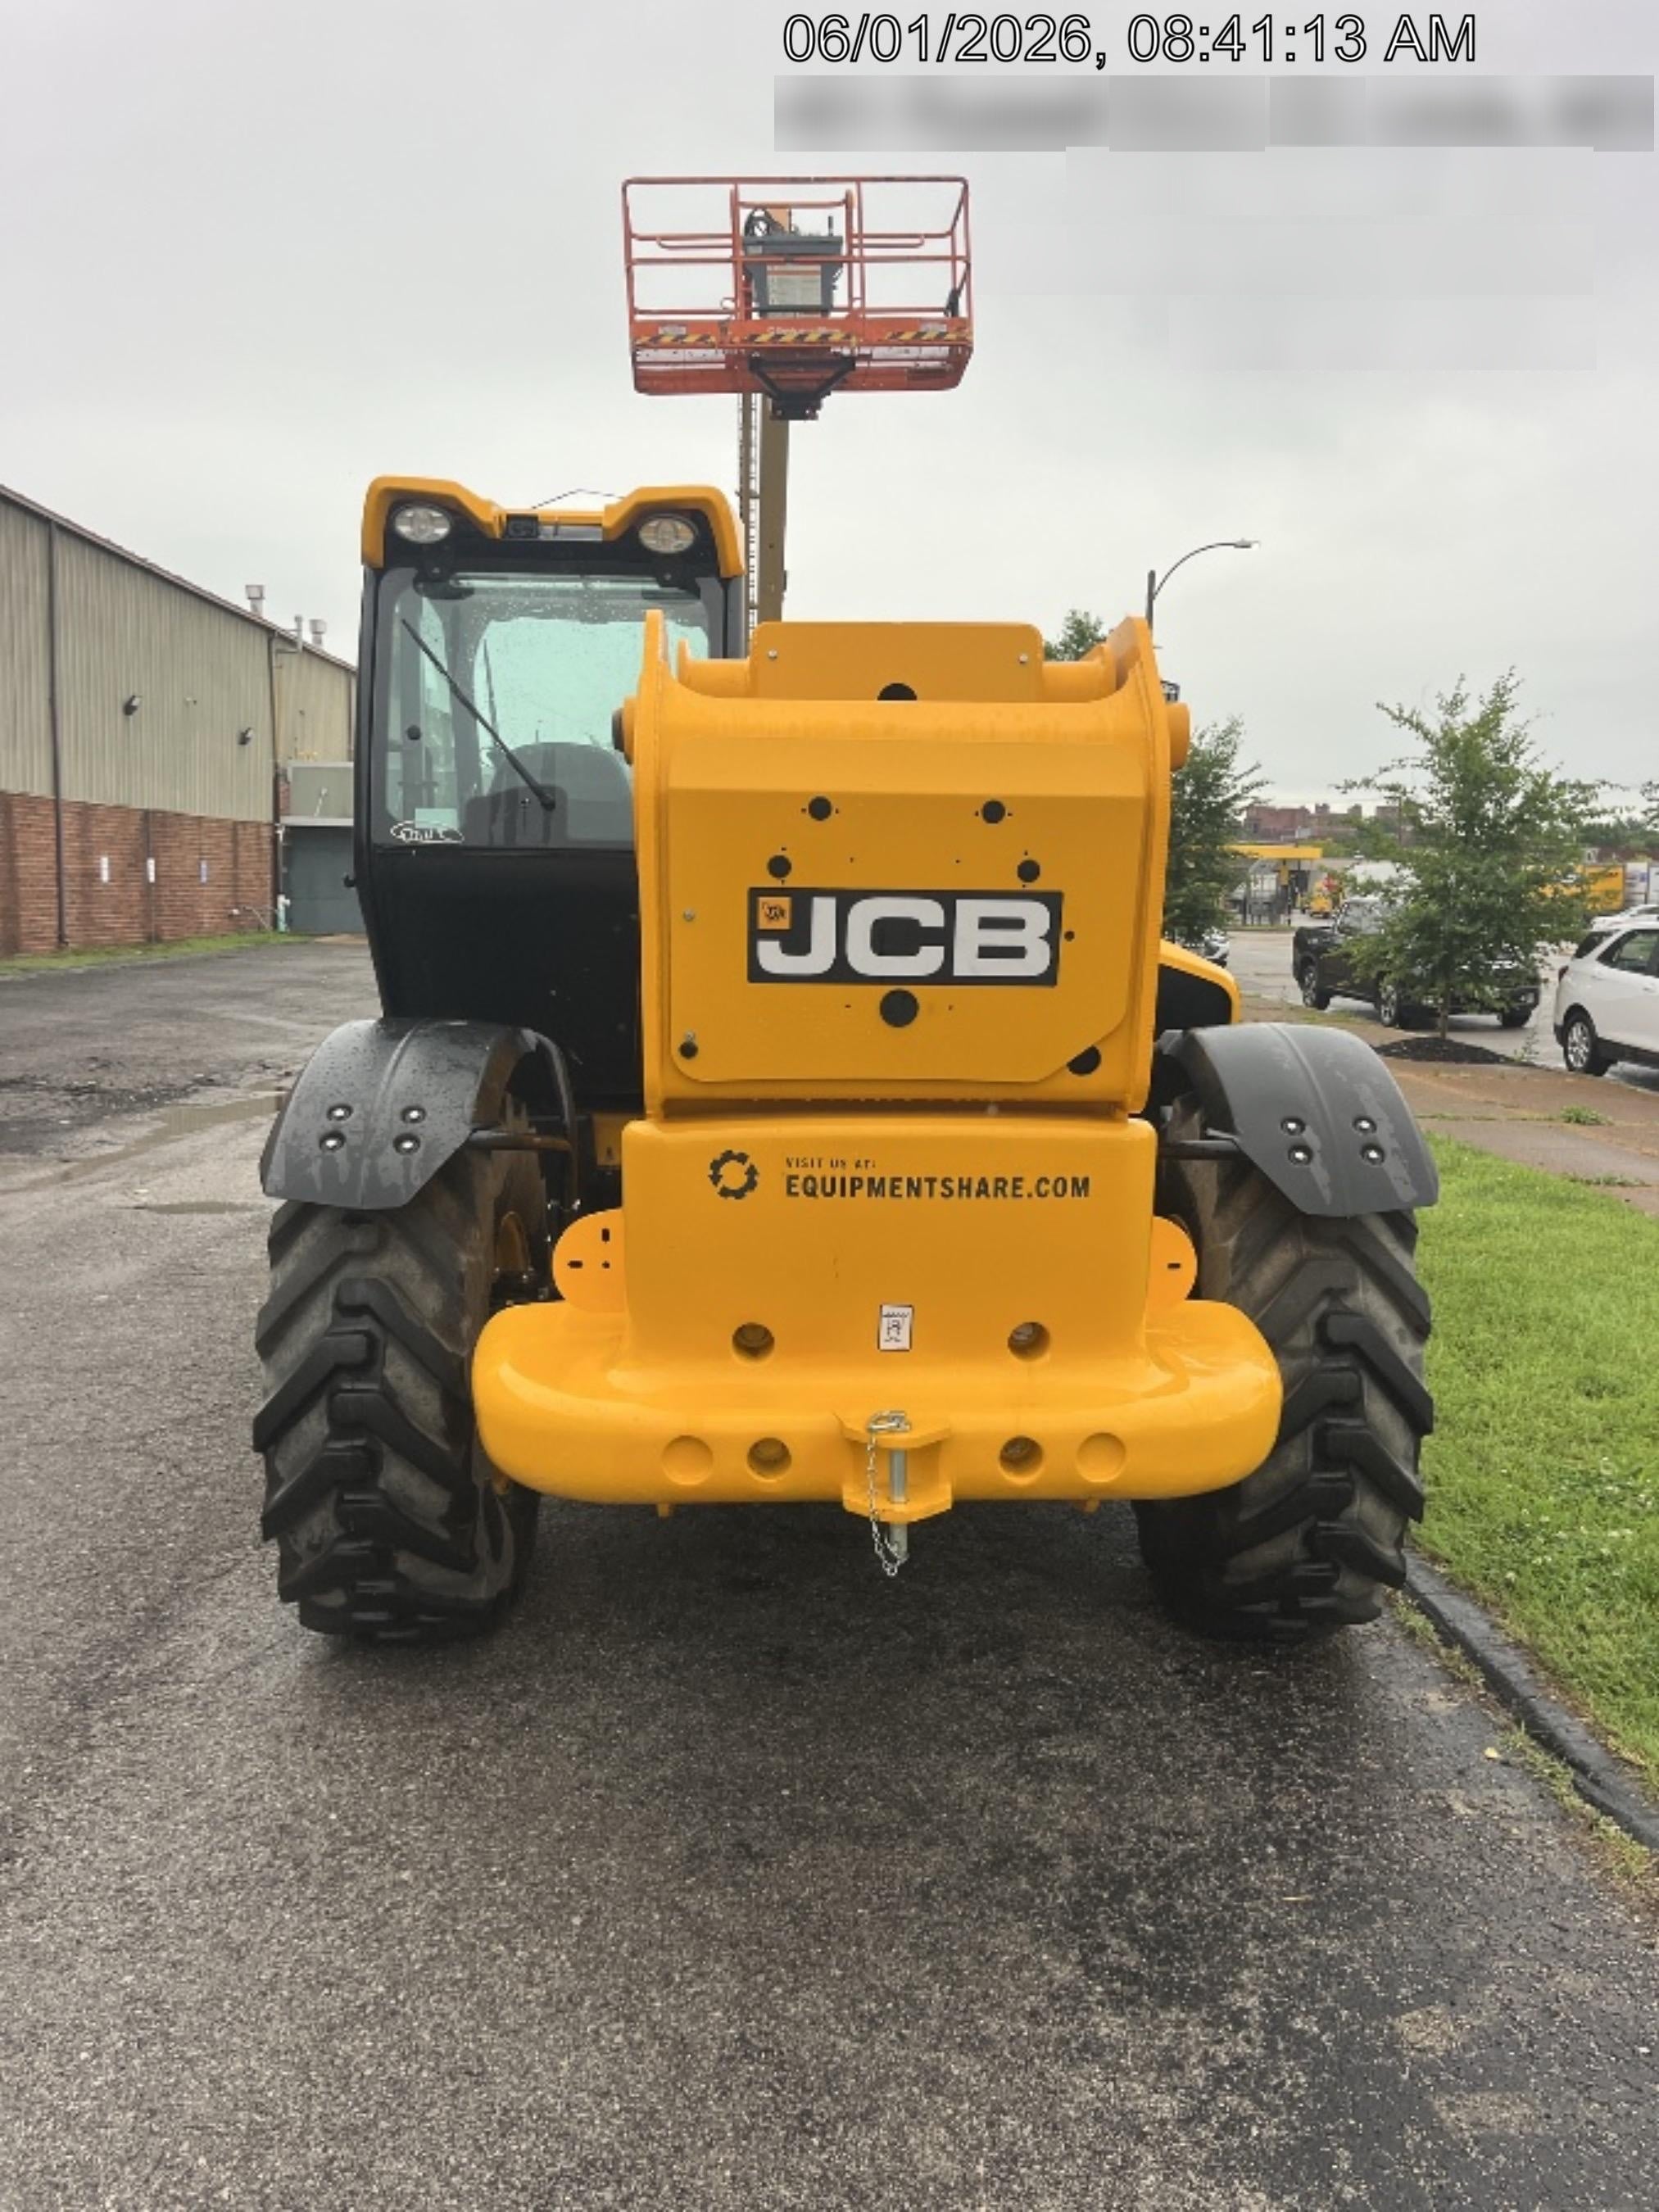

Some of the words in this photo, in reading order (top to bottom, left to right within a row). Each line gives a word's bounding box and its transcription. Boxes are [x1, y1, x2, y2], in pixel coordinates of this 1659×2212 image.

[757, 896, 1051, 977] JCB
[786, 1157, 823, 1168] VISIT
[830, 1158, 847, 1169] US
[786, 1174, 1090, 1199] EQUIPMENTSHARE.COM
